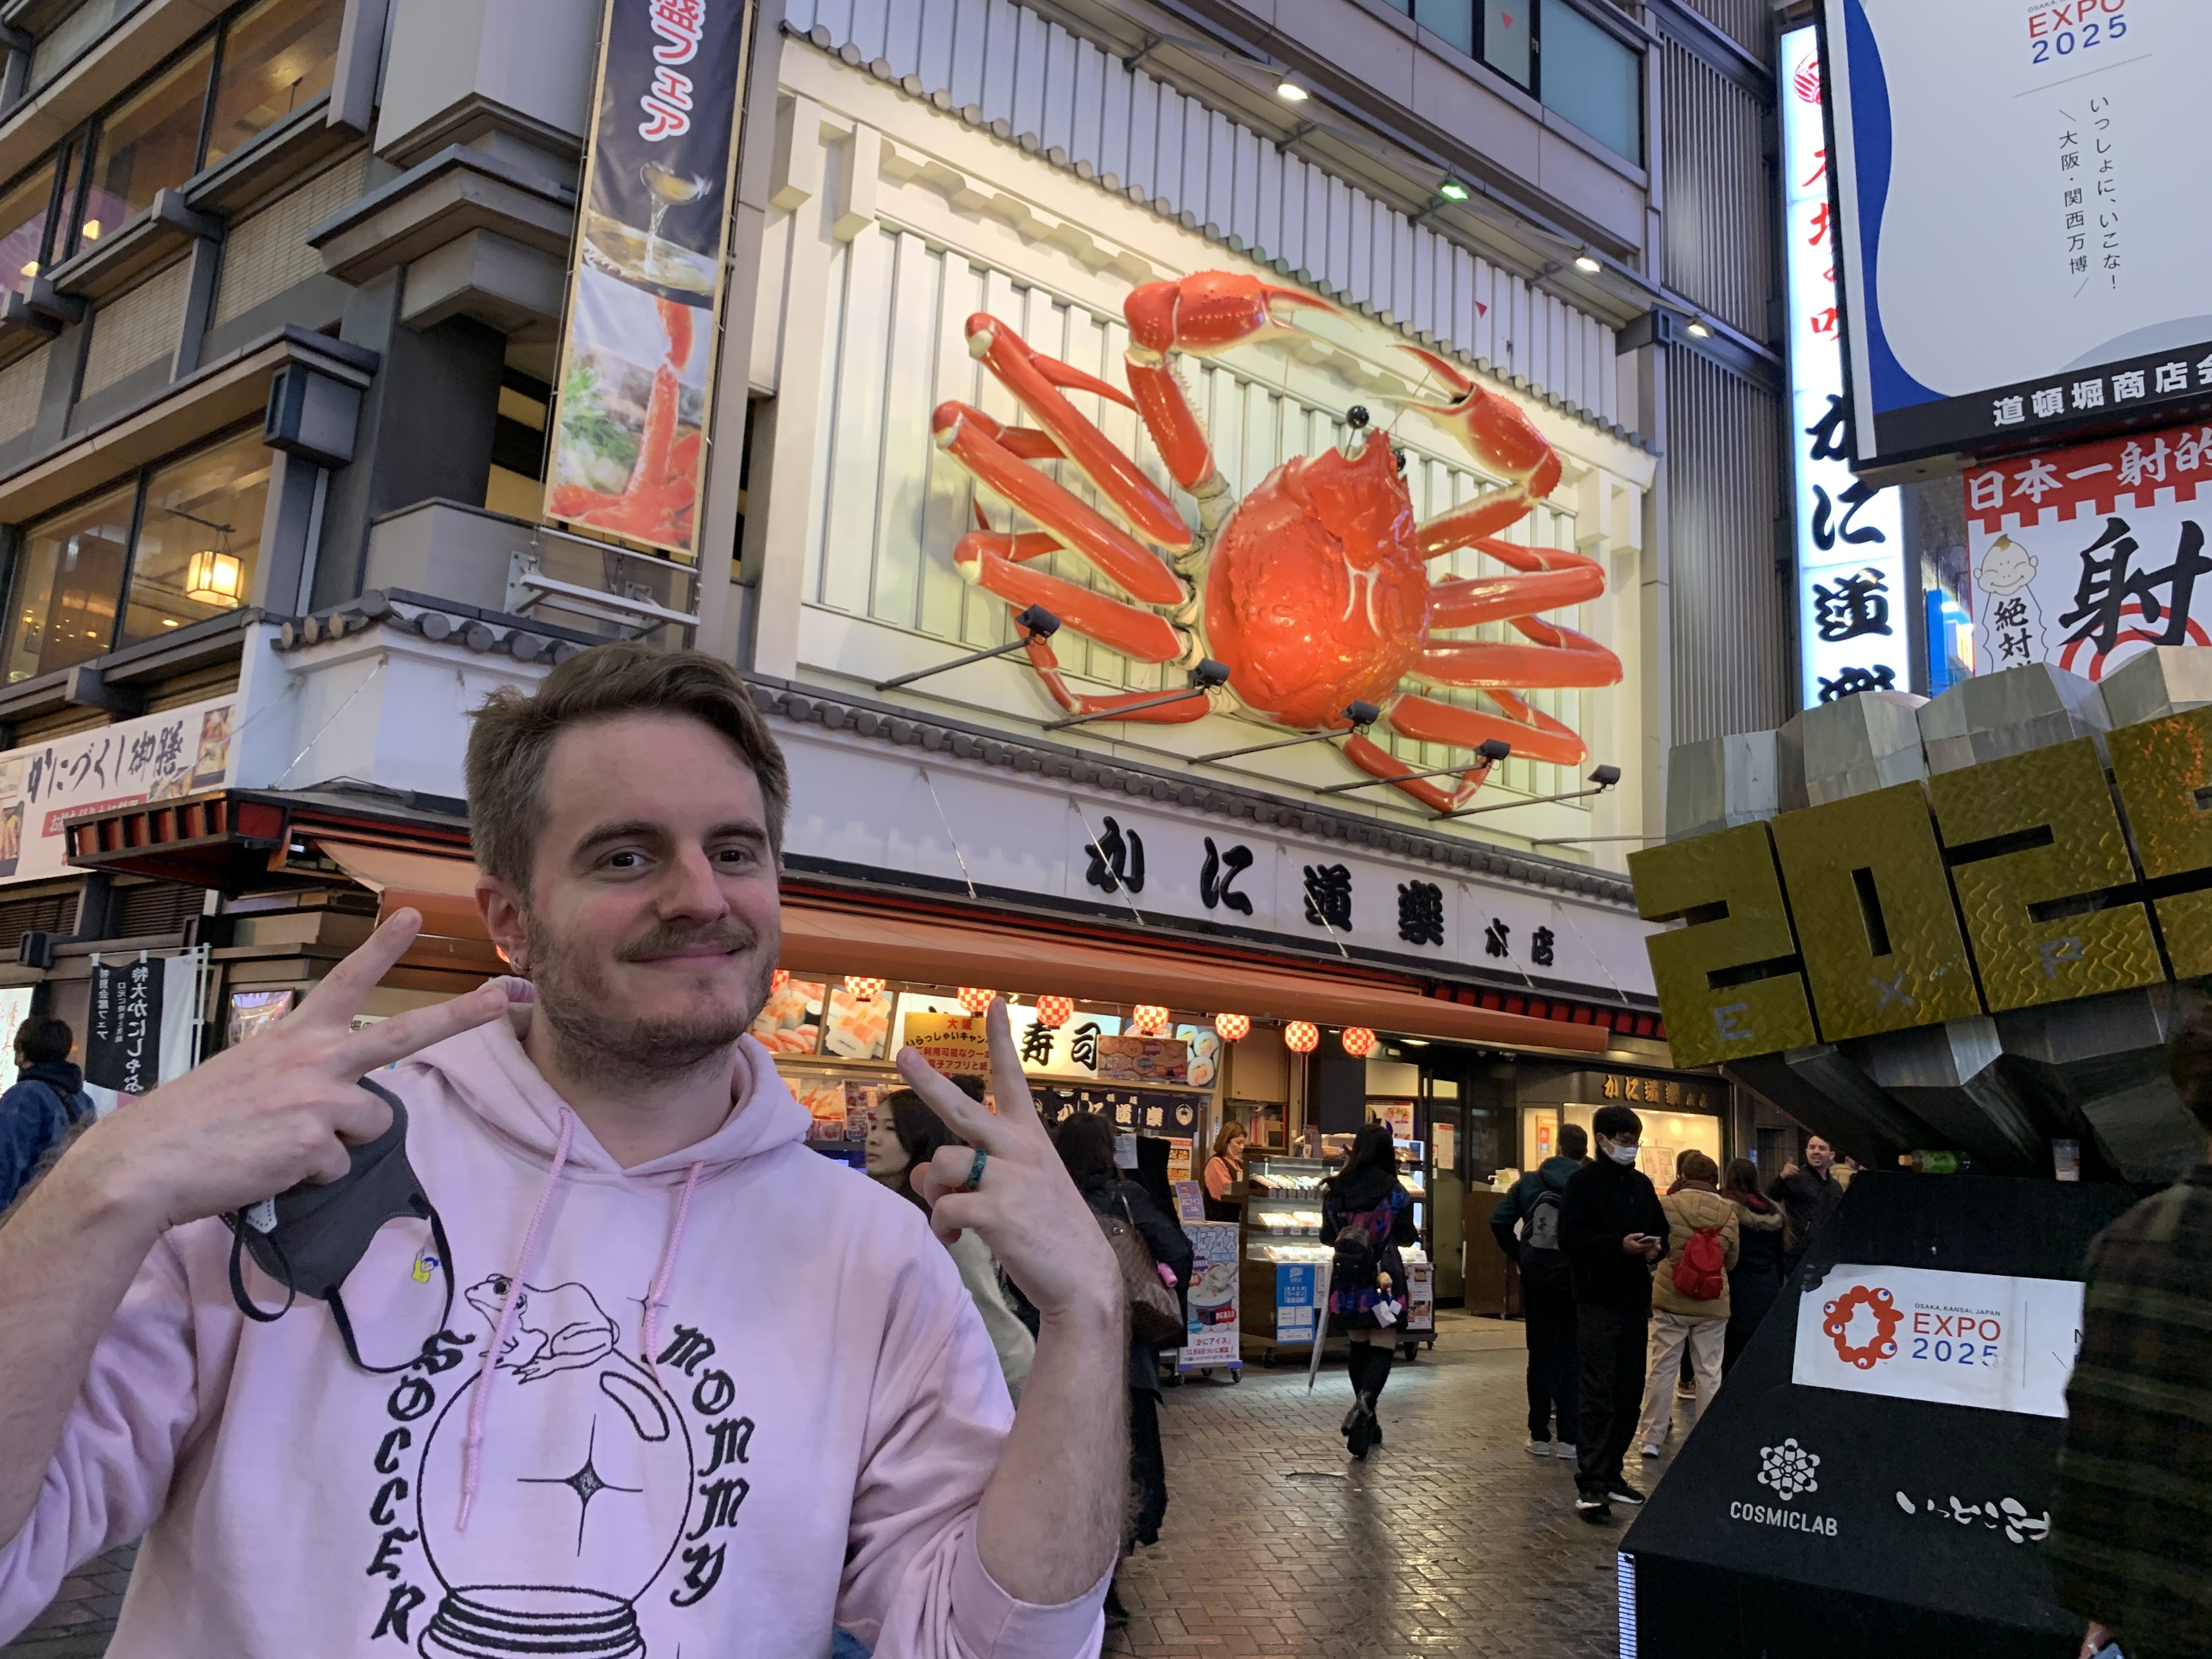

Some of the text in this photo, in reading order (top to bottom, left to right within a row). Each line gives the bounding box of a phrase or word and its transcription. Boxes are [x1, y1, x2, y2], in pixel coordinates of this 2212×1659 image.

[2029, 0, 2125, 38] EXPO
[2032, 14, 2127, 65] 2025
[2059, 130, 2088, 275] 大阪・関西万博
[1994, 597, 2033, 670] 絶対
[906, 1031, 989, 1046] いらっしゃいキャン
[1020, 1016, 1102, 1071] 寿司
[1913, 1312, 2001, 1341] EXPO
[1914, 1302, 1943, 1311] OSAKA,
[366, 1329, 476, 1644] SOCCER
[656, 1323, 755, 1607] MOMMY
[1730, 1500, 1838, 1537] COSMICLAB
